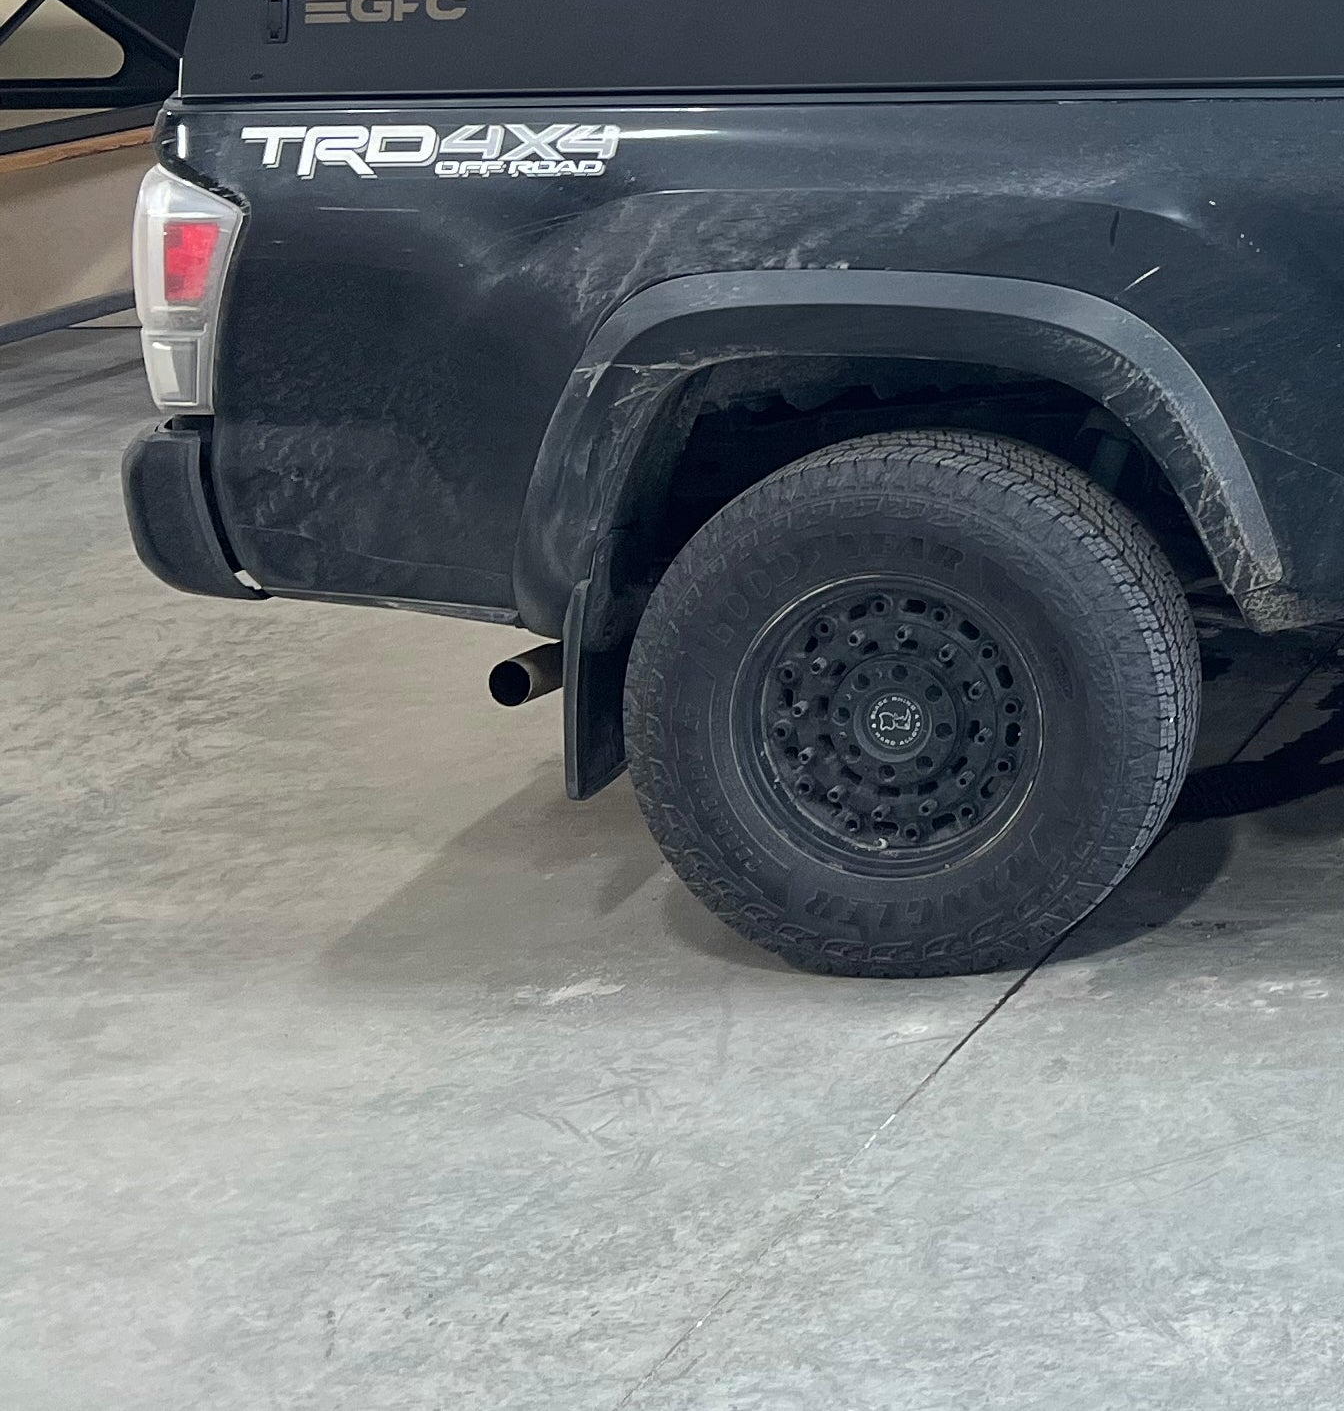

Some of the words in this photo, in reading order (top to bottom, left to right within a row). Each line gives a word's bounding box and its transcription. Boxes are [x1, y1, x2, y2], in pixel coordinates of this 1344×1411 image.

[240, 123, 440, 179] TRD
[434, 159, 506, 177] OFF
[507, 160, 605, 177] ROAD
